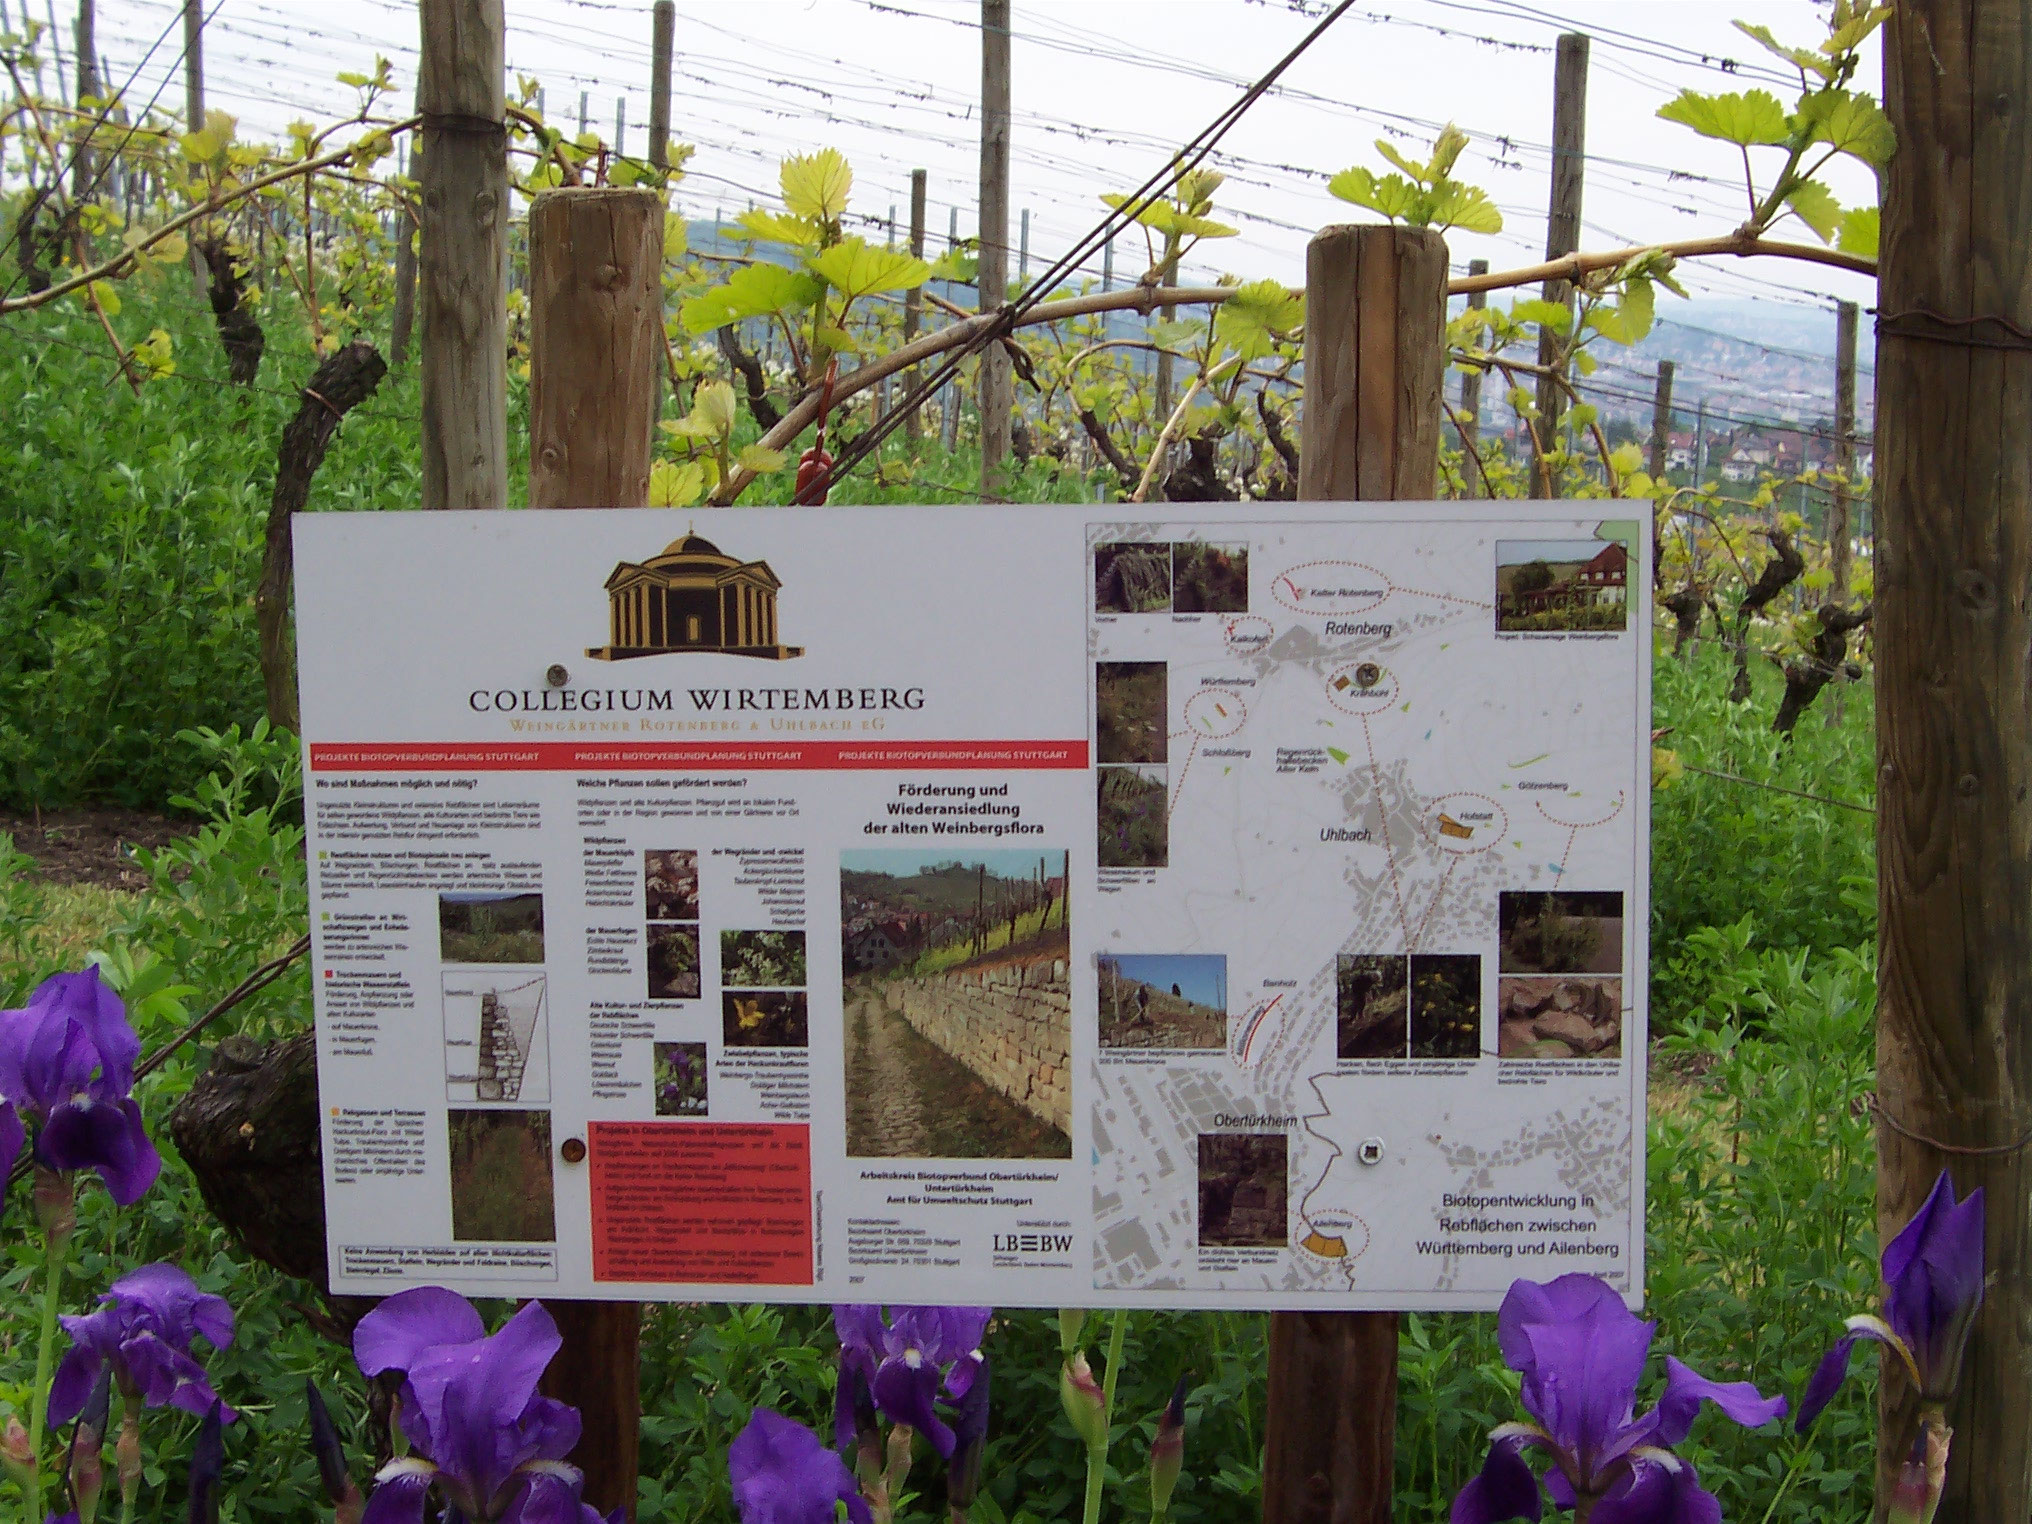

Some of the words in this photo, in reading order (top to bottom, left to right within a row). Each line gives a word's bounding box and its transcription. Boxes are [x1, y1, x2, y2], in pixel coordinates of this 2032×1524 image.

[1325, 621, 1392, 638] Rotenberg
[470, 689, 674, 712] COLLEGIUM
[687, 687, 925, 710] WIRTEMBERG
[314, 752, 359, 762] PROJEKTE
[361, 752, 485, 762] BIOTOPVERBUNDPLANUNG
[485, 752, 539, 762] STUTTGART
[575, 752, 620, 761] PROJEKTE
[622, 752, 746, 761] BIOTOPVERBUNDPLANUNG
[748, 752, 802, 761] STUTTGART
[838, 751, 884, 760] PROJEKTE
[886, 751, 1012, 760] BIOTOPVERBUNDPLANUNG
[1013, 751, 1068, 760] STUTTGART
[316, 779, 329, 788] Wo
[331, 779, 348, 788] sind
[350, 779, 399, 788] Maßnahmen
[401, 779, 432, 790] möglich
[435, 779, 450, 788] und
[452, 779, 478, 790] nötig?
[577, 779, 606, 788] Welche
[609, 779, 644, 788] Pflanzen
[646, 779, 671, 788] sollen
[672, 779, 710, 789] gefördert
[712, 779, 747, 788] werden?
[898, 784, 975, 799] Förderung
[979, 783, 1008, 796] und
[887, 802, 1020, 817] Wiederansiedlung
[863, 822, 888, 834] der
[891, 822, 928, 834] alten
[932, 821, 1044, 836] Weinbergsflora
[1320, 828, 1372, 842] Uhlbach
[1214, 1113, 1298, 1127] Obertürkheim
[860, 1171, 915, 1181] Arbeitskreis
[917, 1172, 987, 1182] Biotopverbund
[925, 1184, 994, 1193] Untertürkheim
[886, 1196, 906, 1205] Amt
[908, 1196, 921, 1205] für
[923, 1196, 988, 1205] Umweltschutz
[990, 1196, 1033, 1206] Stuttgart
[1443, 1193, 1577, 1210] Biotopentwicklung
[1581, 1193, 1594, 1207] in
[1439, 1218, 1524, 1233] Rebflächen
[1528, 1218, 1597, 1232] zwischen
[1416, 1241, 1513, 1257] Württemberg
[1517, 1241, 1546, 1255] und
[1549, 1241, 1619, 1258] Ailenberg
